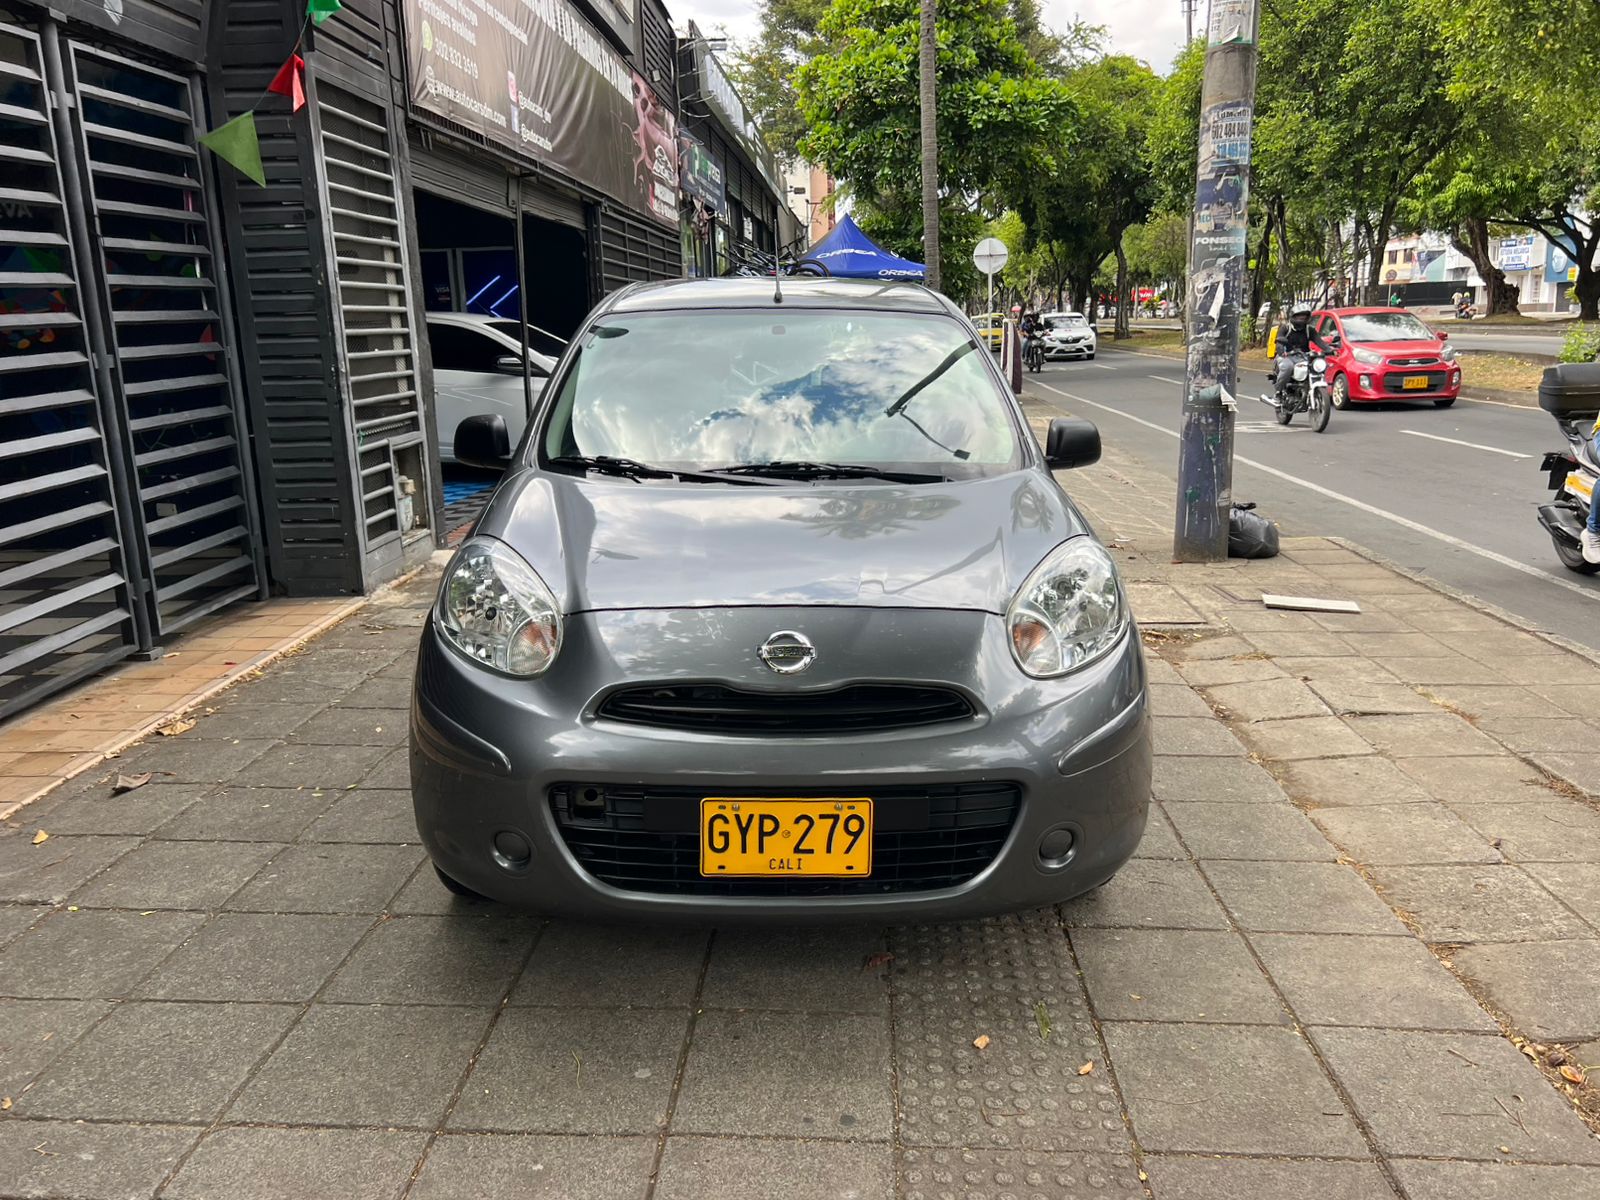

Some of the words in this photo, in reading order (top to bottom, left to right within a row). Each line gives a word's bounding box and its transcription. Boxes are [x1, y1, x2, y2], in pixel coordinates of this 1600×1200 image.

[434, 38, 449, 62] 302
[816, 248, 878, 259] ORBEA
[878, 269, 924, 277] ORBEA
[708, 813, 780, 854] GYP
[793, 813, 865, 854] 279
[769, 858, 802, 870] CALI
